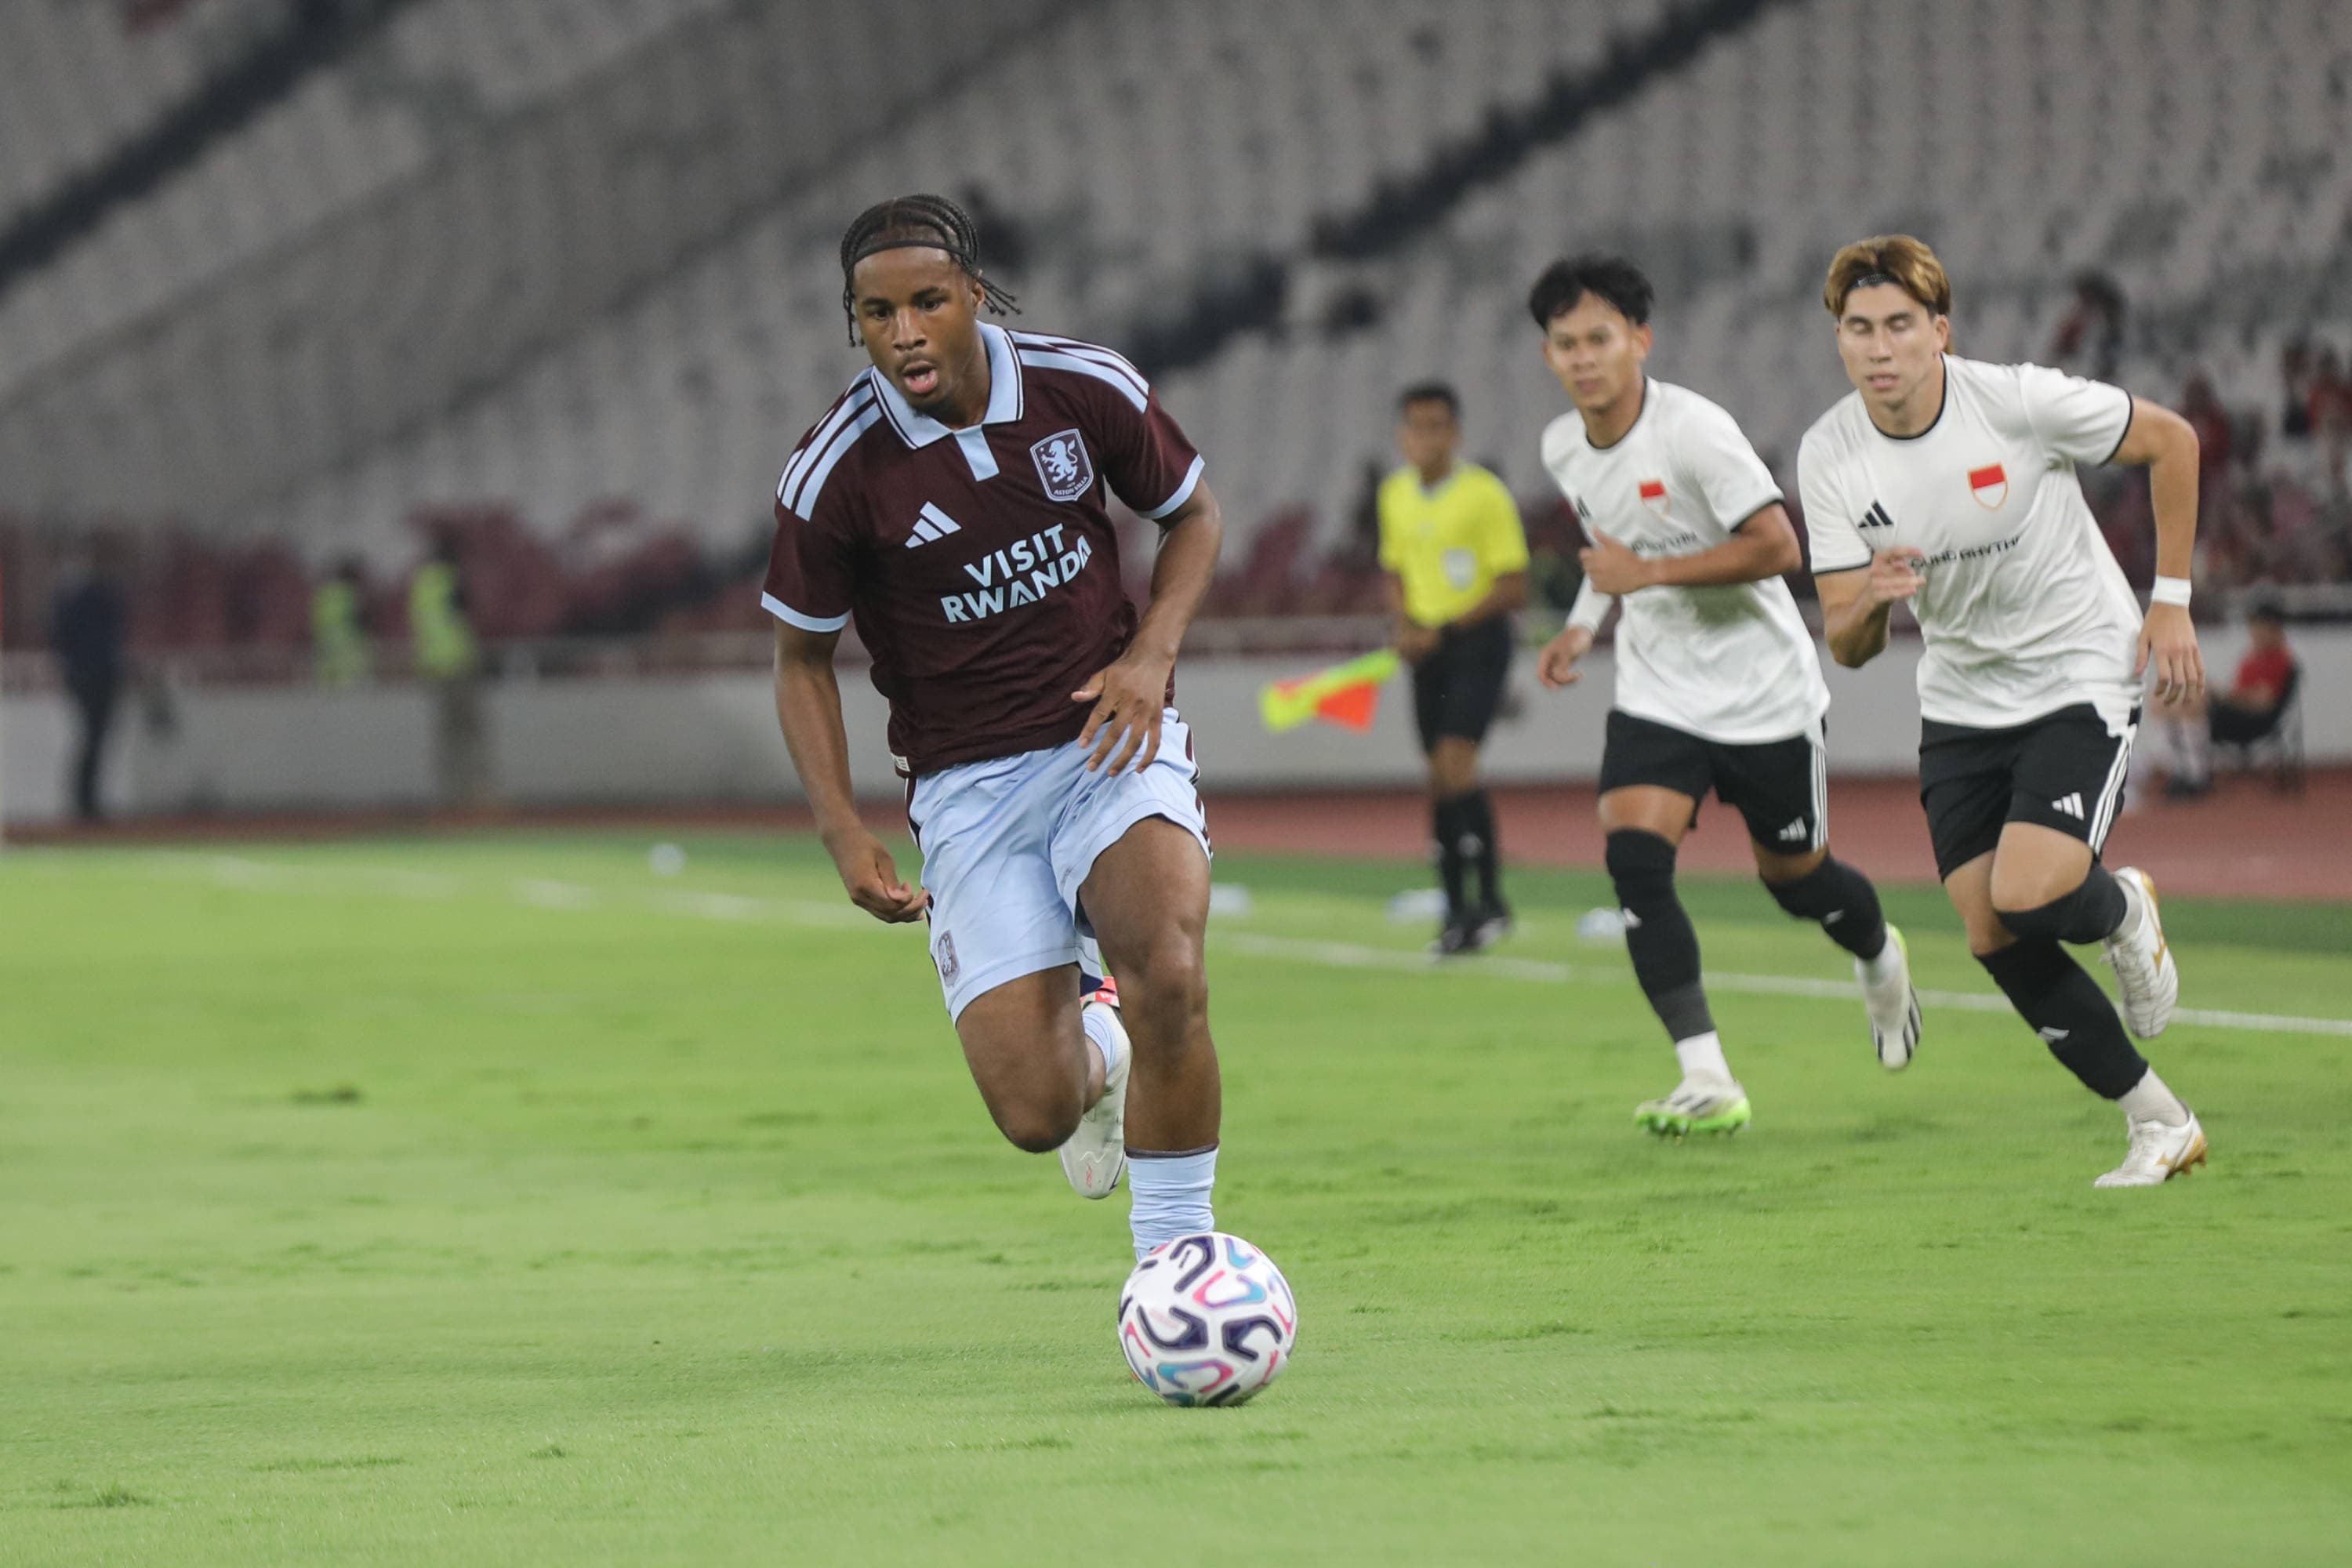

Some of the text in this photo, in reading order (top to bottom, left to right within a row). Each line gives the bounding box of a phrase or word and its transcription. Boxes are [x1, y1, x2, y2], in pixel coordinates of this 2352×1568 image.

[941, 535, 1092, 623] RWANDA
[964, 523, 1064, 587] VISIT
[1911, 550, 1957, 568] OUND
